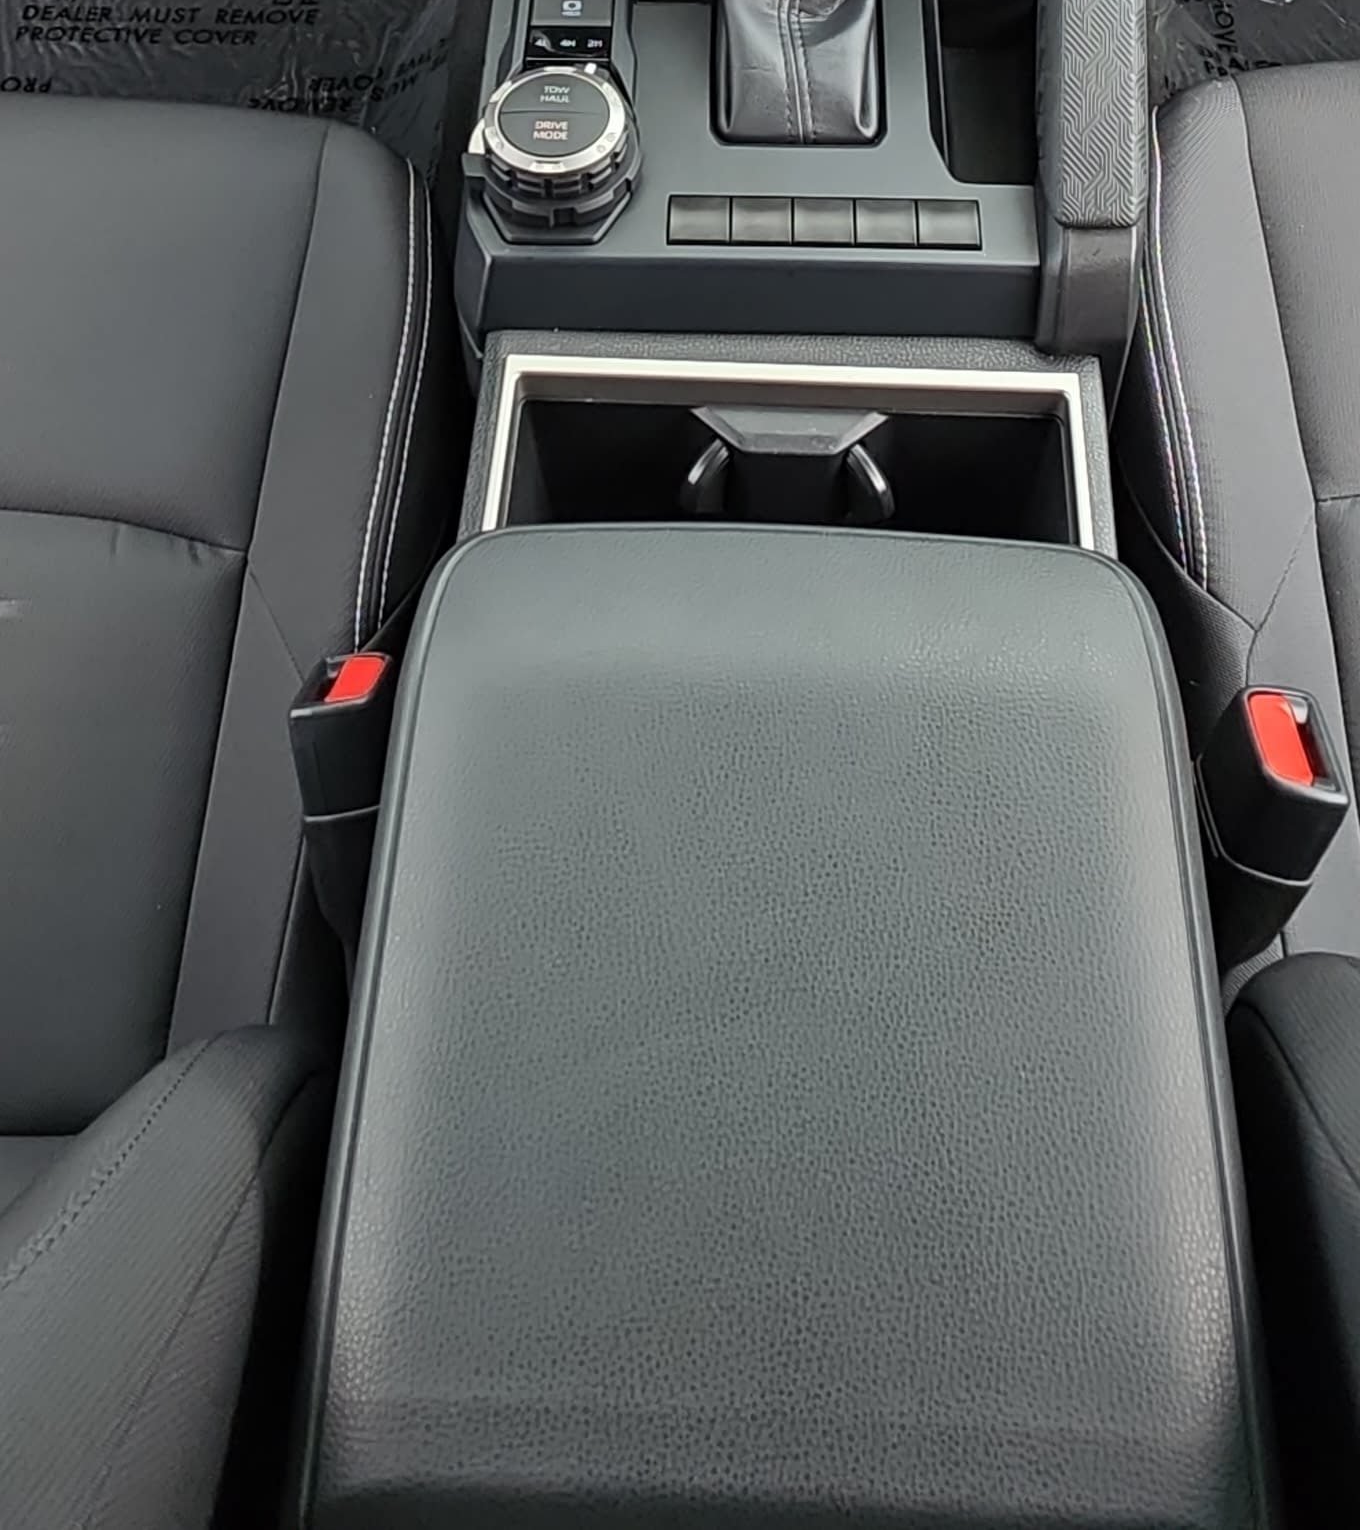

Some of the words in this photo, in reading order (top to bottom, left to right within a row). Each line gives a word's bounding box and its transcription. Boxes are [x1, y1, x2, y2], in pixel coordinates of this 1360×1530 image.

[22, 4, 113, 22] DEALER
[132, 7, 200, 25] MUST
[215, 7, 320, 26] REMOVE
[15, 25, 162, 46] PROTECTIVE
[175, 28, 257, 46] COVER
[543, 85, 571, 95] TOW
[540, 94, 570, 103] HAUL
[534, 120, 569, 130] DRIVE
[533, 130, 569, 141] MODE
